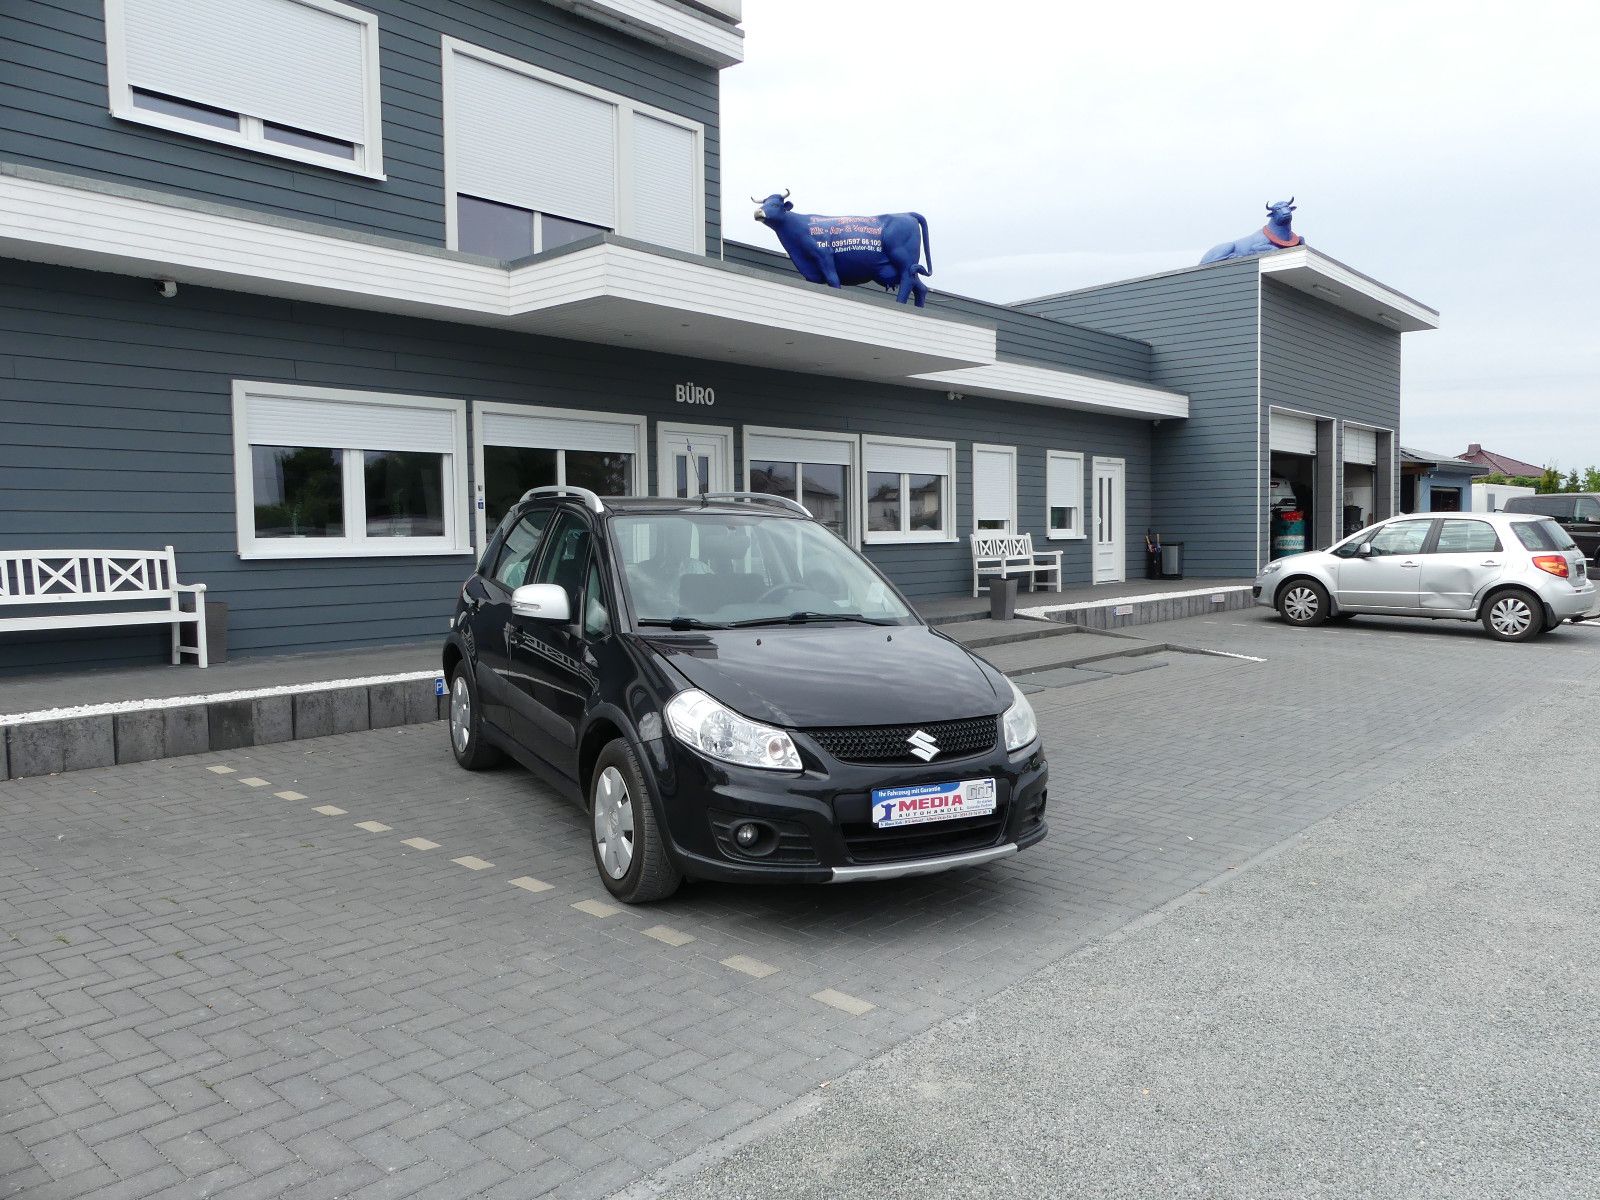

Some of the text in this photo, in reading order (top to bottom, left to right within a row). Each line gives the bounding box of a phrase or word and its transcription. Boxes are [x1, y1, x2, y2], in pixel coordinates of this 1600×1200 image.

[676, 382, 715, 406] BÜRO
[898, 794, 964, 813] MEDIA
[898, 806, 964, 818] AUTOHANDEL
